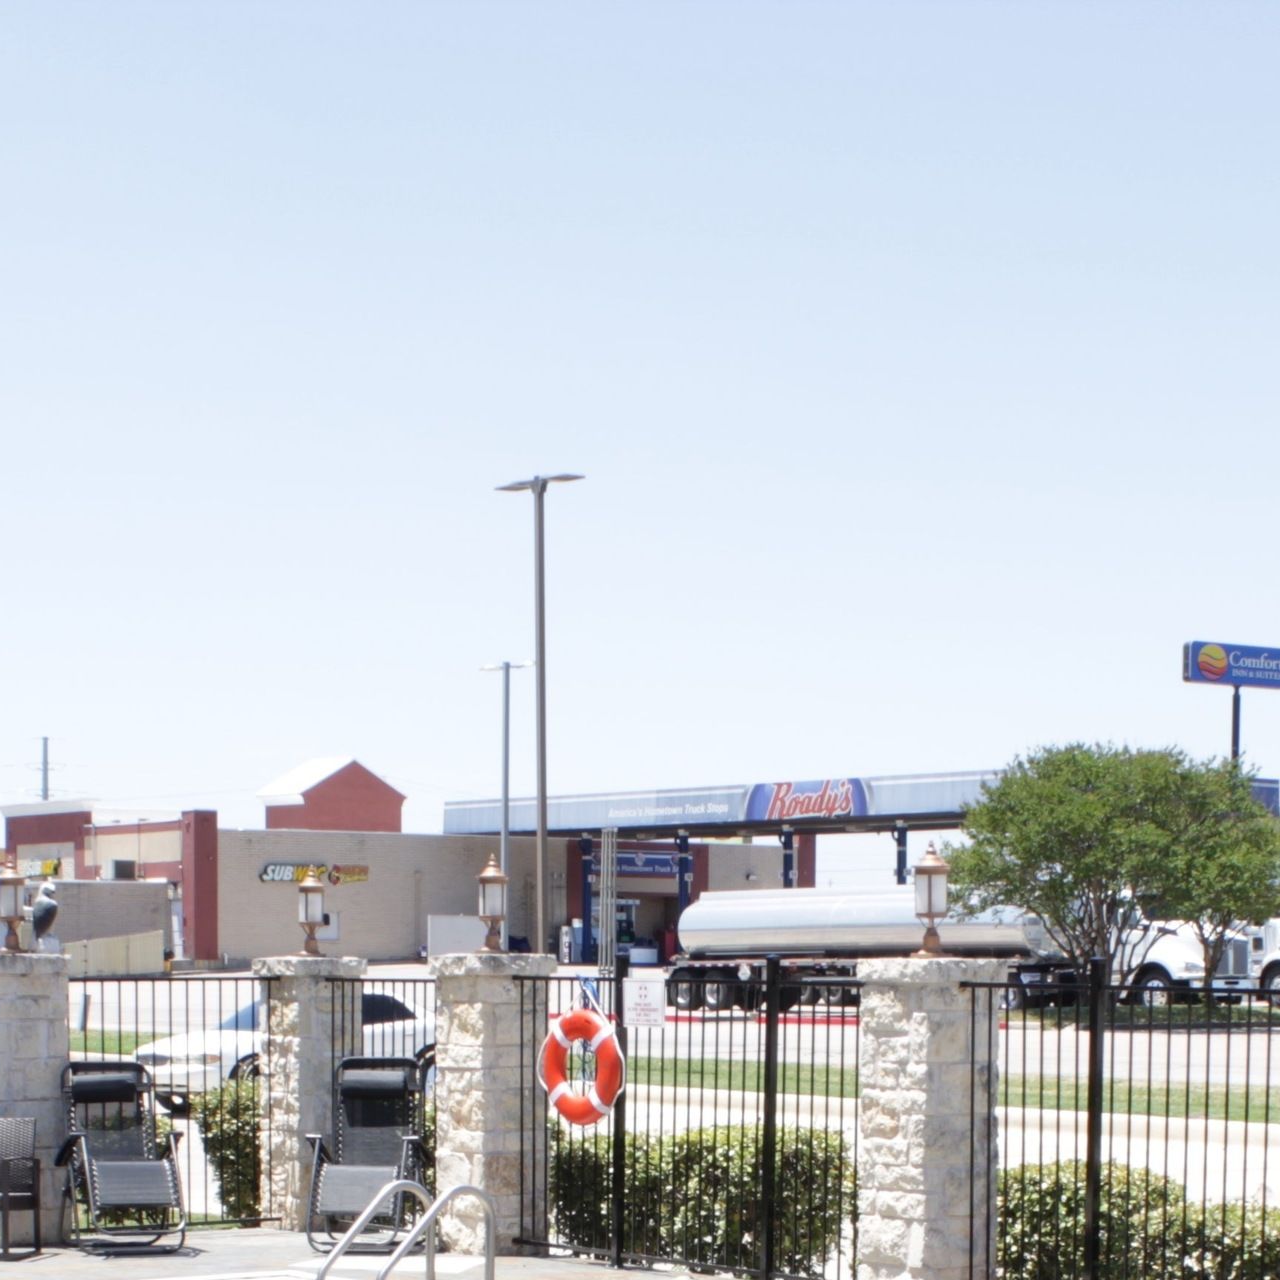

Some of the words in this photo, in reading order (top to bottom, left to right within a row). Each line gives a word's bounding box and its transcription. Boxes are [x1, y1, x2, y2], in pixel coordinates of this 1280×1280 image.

[1231, 669, 1248, 677] INN
[766, 778, 853, 820] Roady's
[644, 805, 683, 816] Hometown
[684, 804, 705, 814] Truck
[707, 803, 729, 815] Stops
